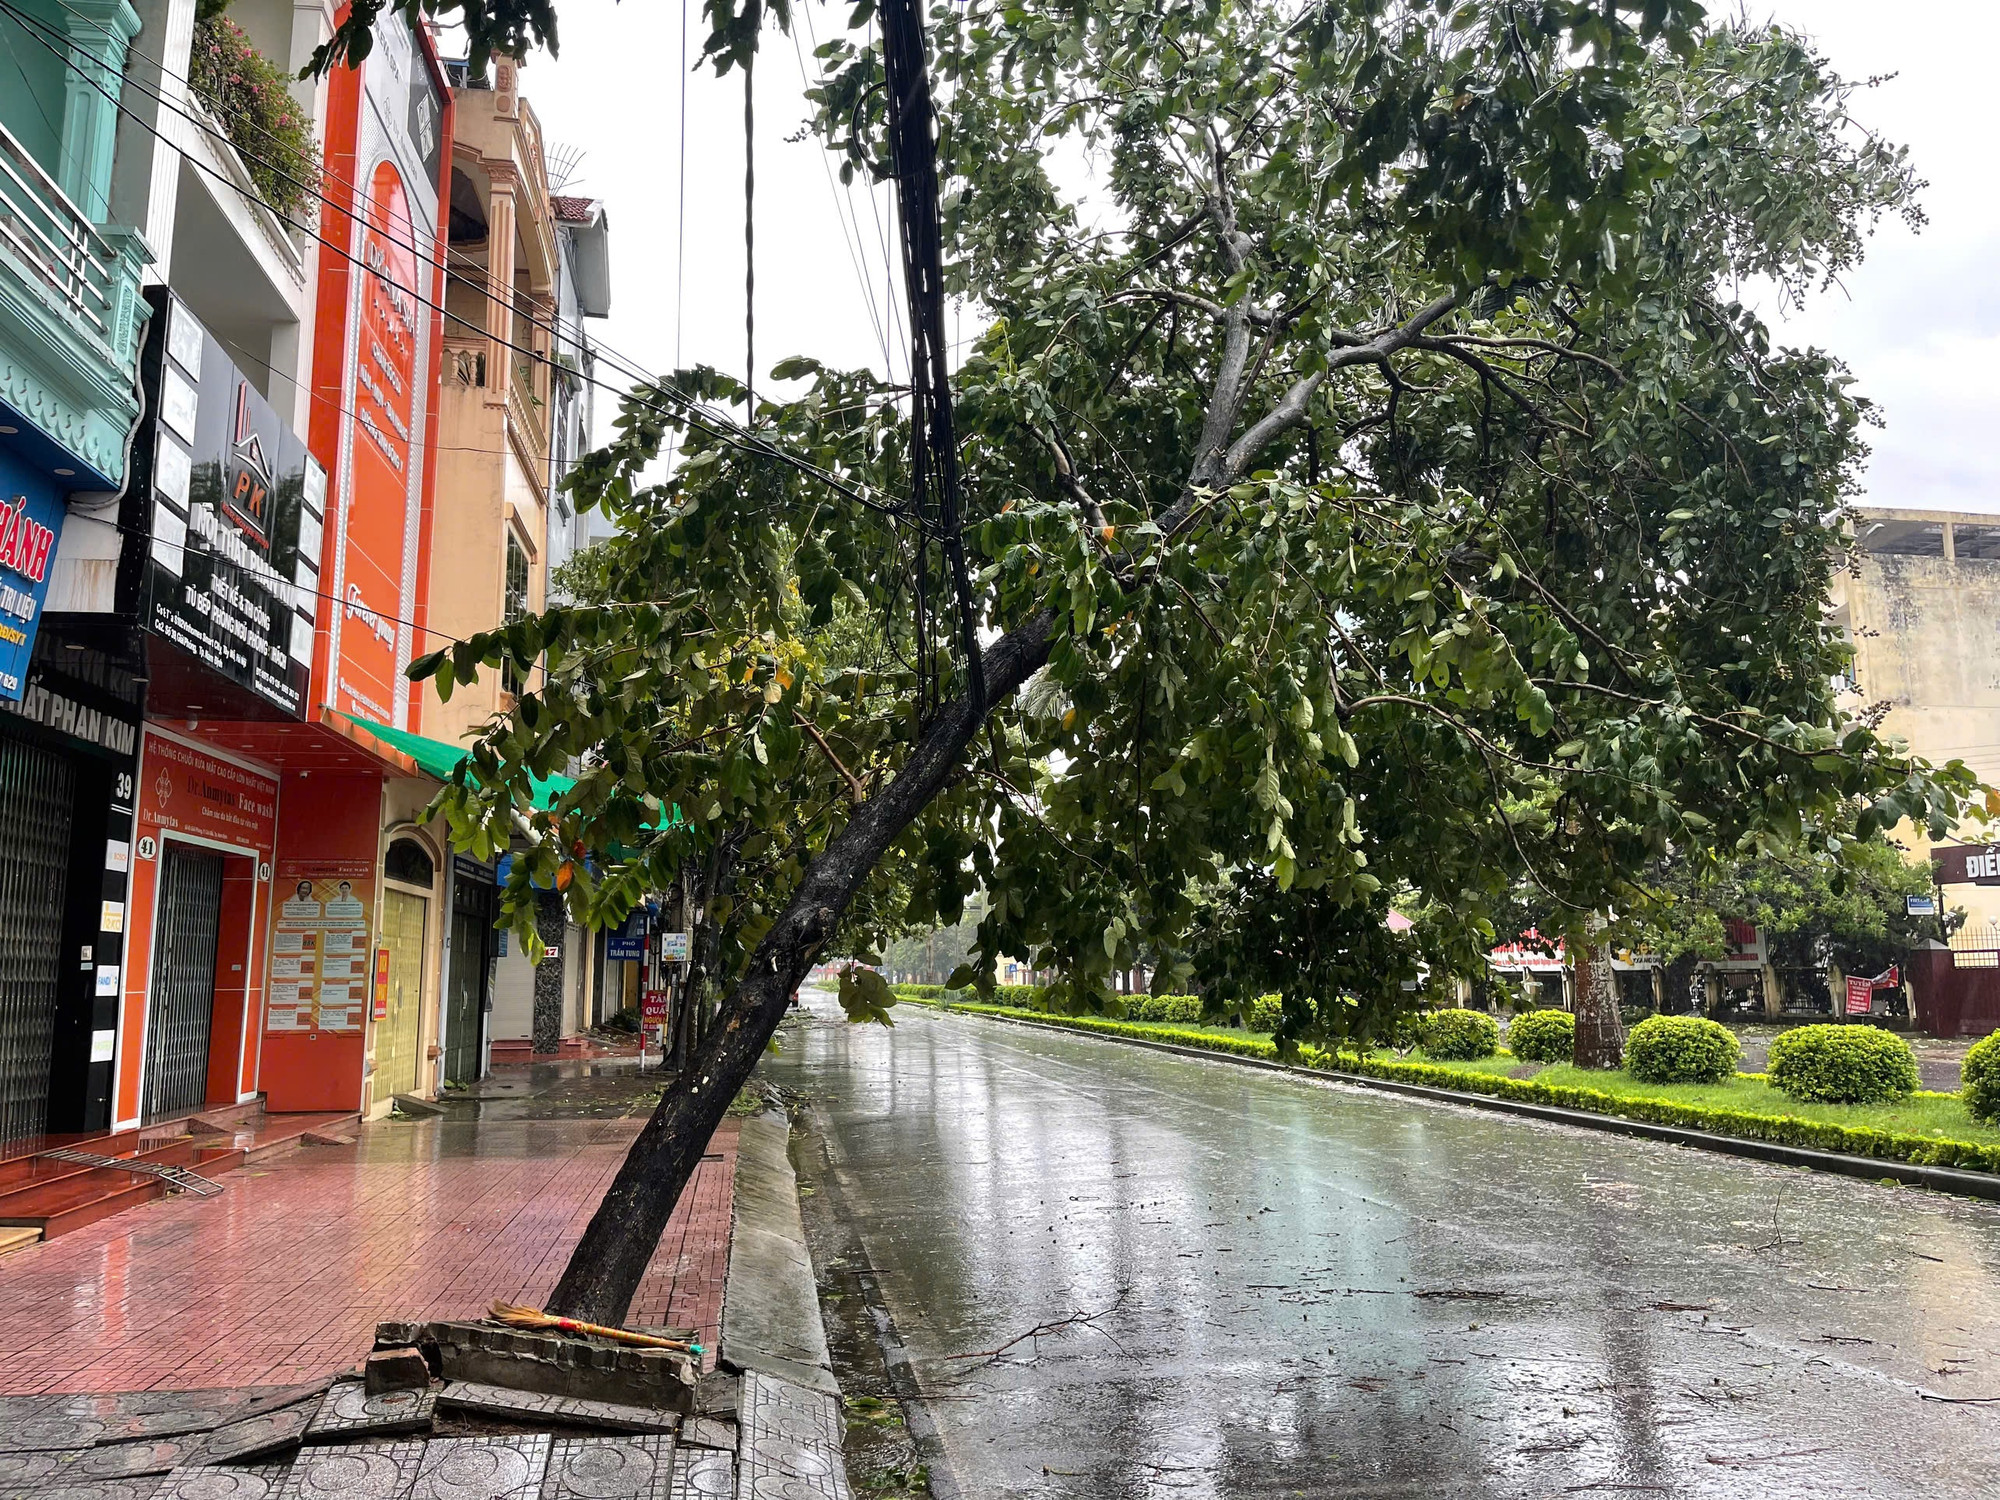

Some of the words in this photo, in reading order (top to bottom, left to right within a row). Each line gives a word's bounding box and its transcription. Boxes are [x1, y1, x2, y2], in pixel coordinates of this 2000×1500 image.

[233, 470, 266, 518] PK
[189, 502, 218, 551] NỘI
[217, 523, 249, 571] THẤT
[210, 573, 229, 601] THIẾT
[253, 605, 271, 632] CÔNG
[185, 584, 198, 608] TỦ
[197, 591, 211, 616] BẾP
[210, 606, 234, 636] PHÒNG
[233, 620, 248, 642] NGỦ
[247, 629, 269, 656] PHÒNG
[268, 645, 288, 670] HÁCH
[3, 674, 18, 691] 629
[51, 692, 102, 743] PHAN
[105, 715, 136, 756] KIM
[148, 740, 157, 756] HỆ
[157, 744, 177, 760] THỐNG
[177, 751, 194, 766] CHUỖI
[206, 761, 217, 775] MẶT
[216, 765, 227, 778] CAO
[227, 768, 236, 781] CẤP
[116, 772, 131, 800] 39
[238, 792, 256, 813] Face
[256, 803, 274, 818] wash
[140, 838, 154, 855] 41
[260, 865, 270, 878] 41
